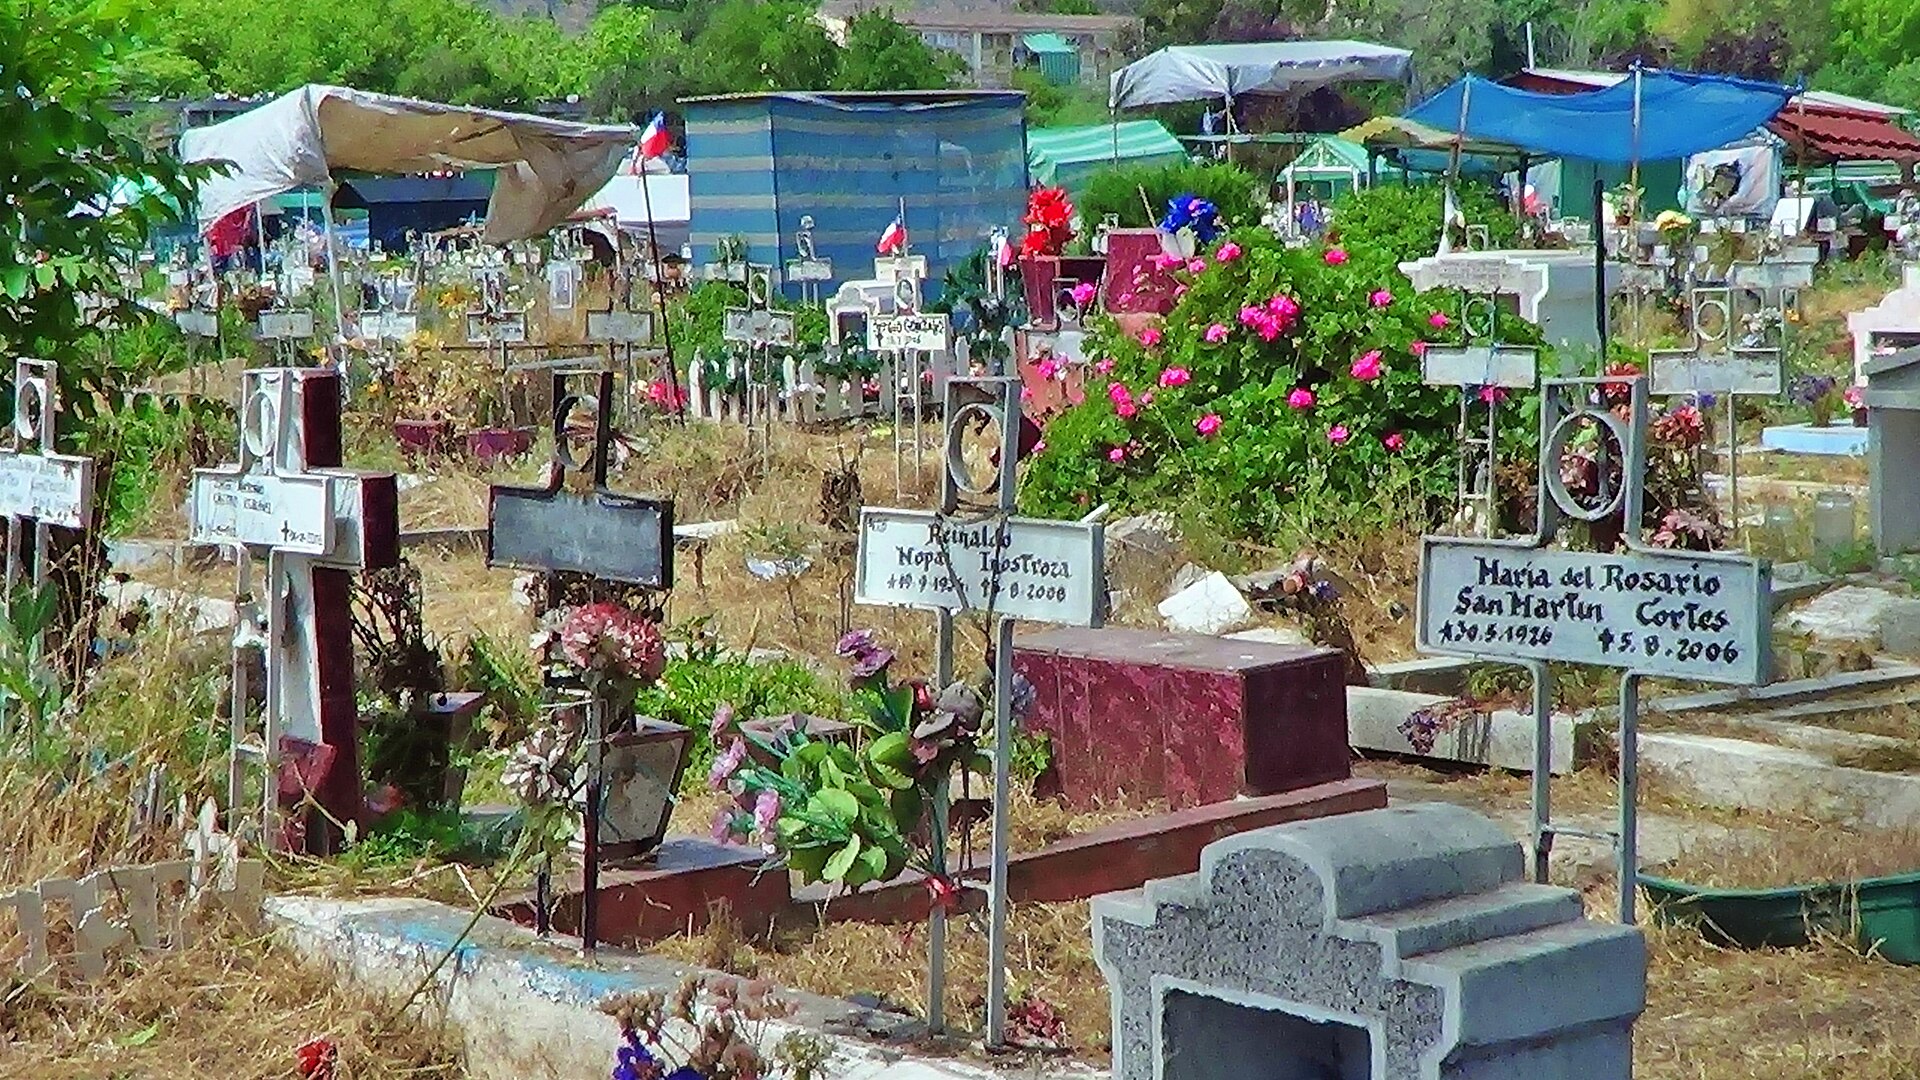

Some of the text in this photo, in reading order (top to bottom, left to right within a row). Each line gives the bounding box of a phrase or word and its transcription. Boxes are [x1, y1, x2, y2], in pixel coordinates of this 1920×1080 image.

[1474, 555, 1721, 597] María del Rosario
[1452, 585, 1504, 616] San
